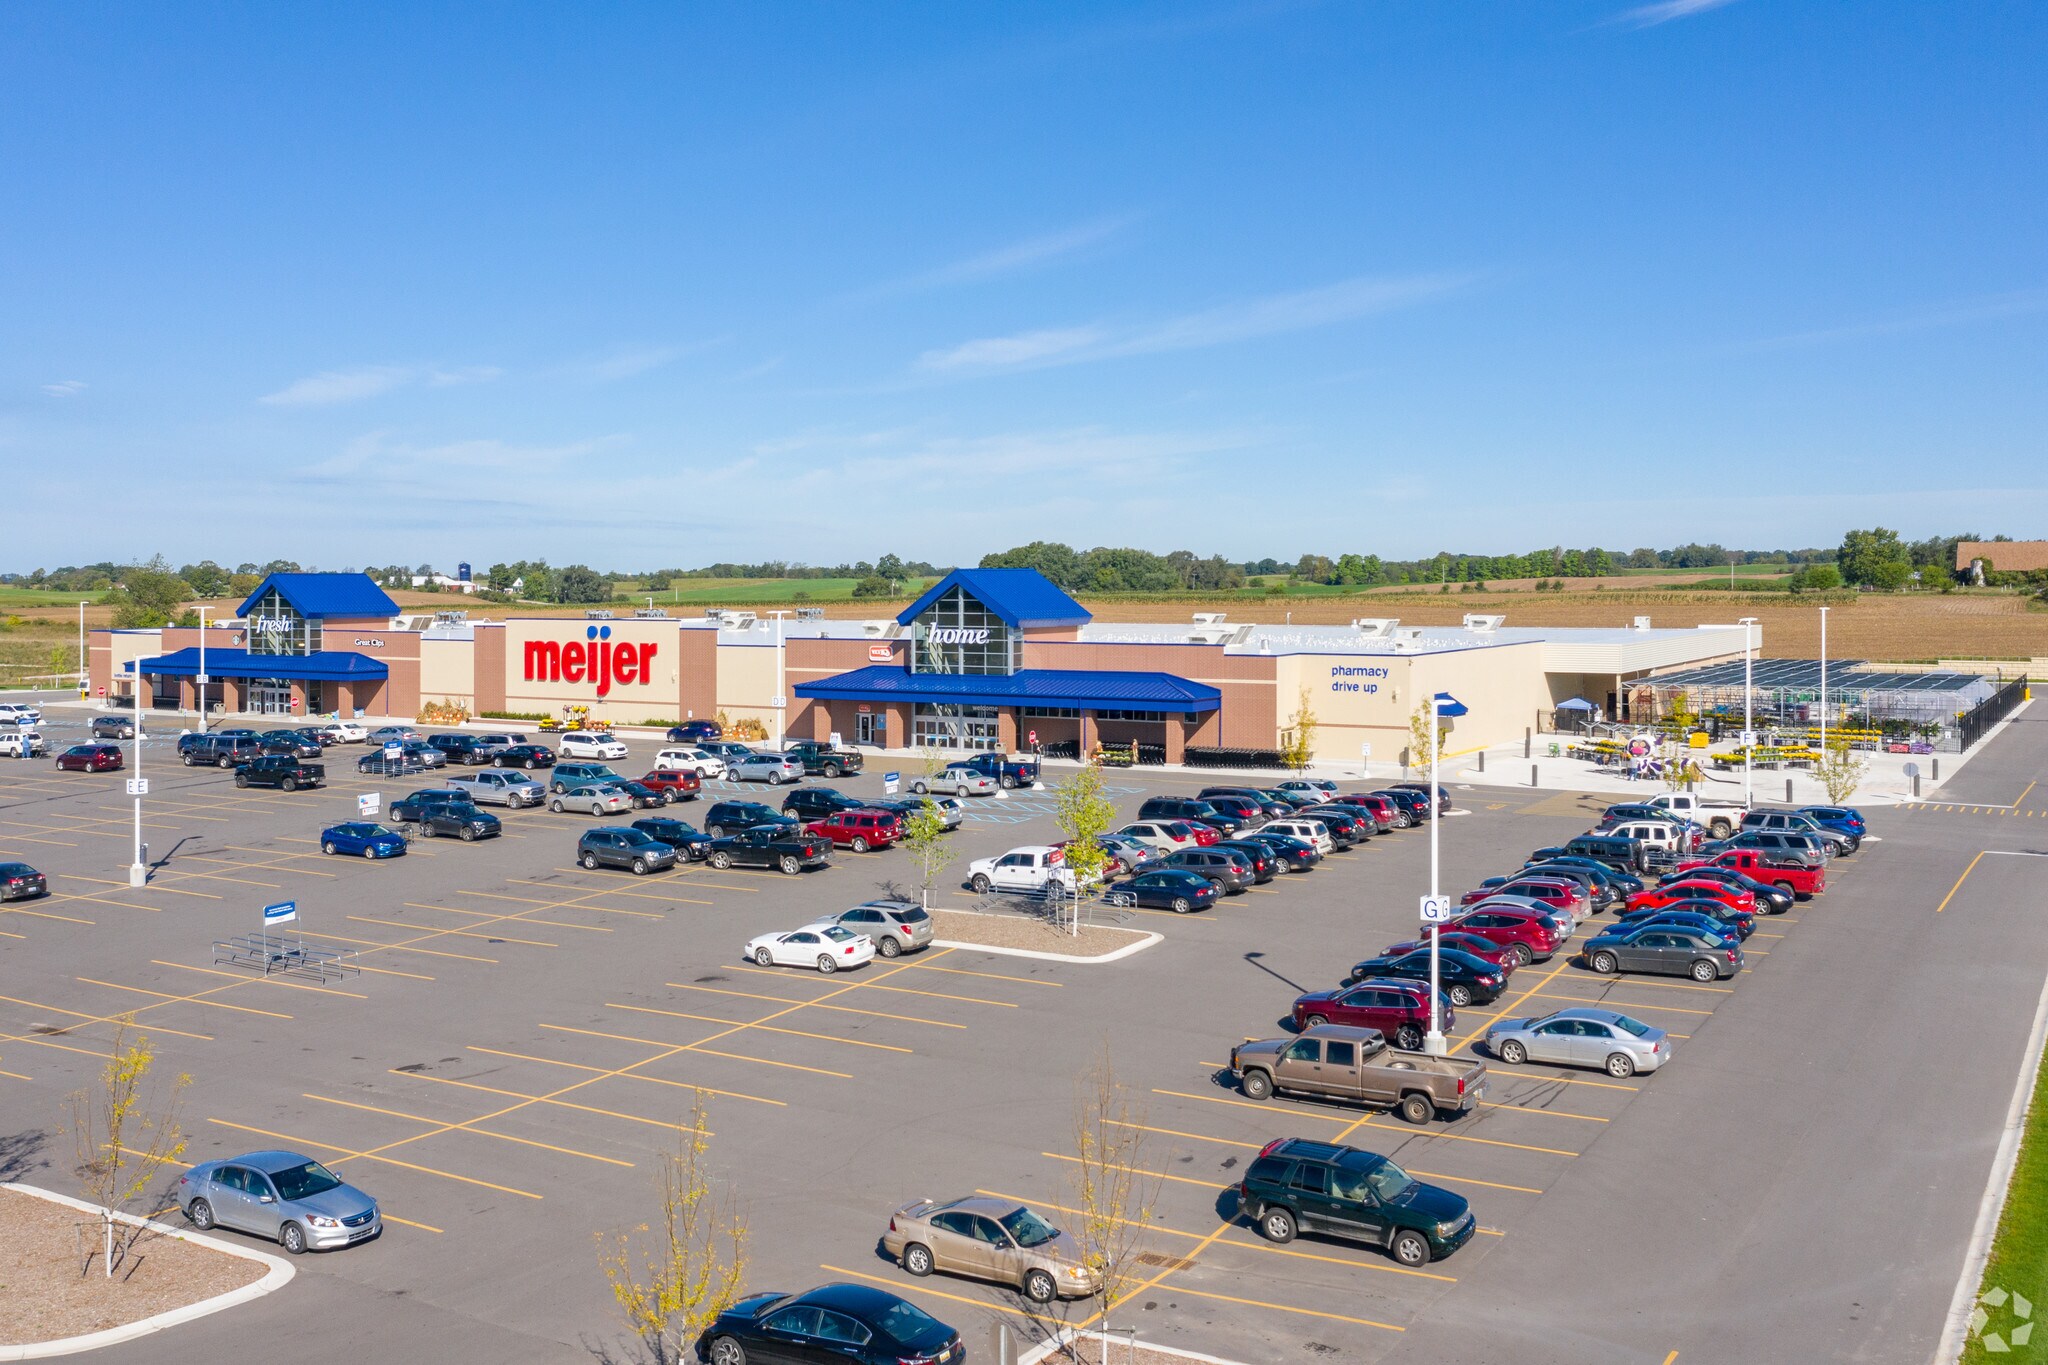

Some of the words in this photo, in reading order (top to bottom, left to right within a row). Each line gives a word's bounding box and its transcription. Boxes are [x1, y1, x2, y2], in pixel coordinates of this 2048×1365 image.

[256, 615, 291, 634] fresh
[928, 622, 989, 644] home
[354, 639, 371, 647] Great
[371, 640, 385, 649] Clips
[524, 625, 658, 697] meijer
[1331, 665, 1389, 679] pharmacy
[1331, 681, 1359, 692] drive
[1363, 684, 1378, 695] up
[1744, 733, 1751, 743] F
[128, 781, 133, 793] E
[138, 781, 145, 793] E
[1424, 900, 1438, 919] G
